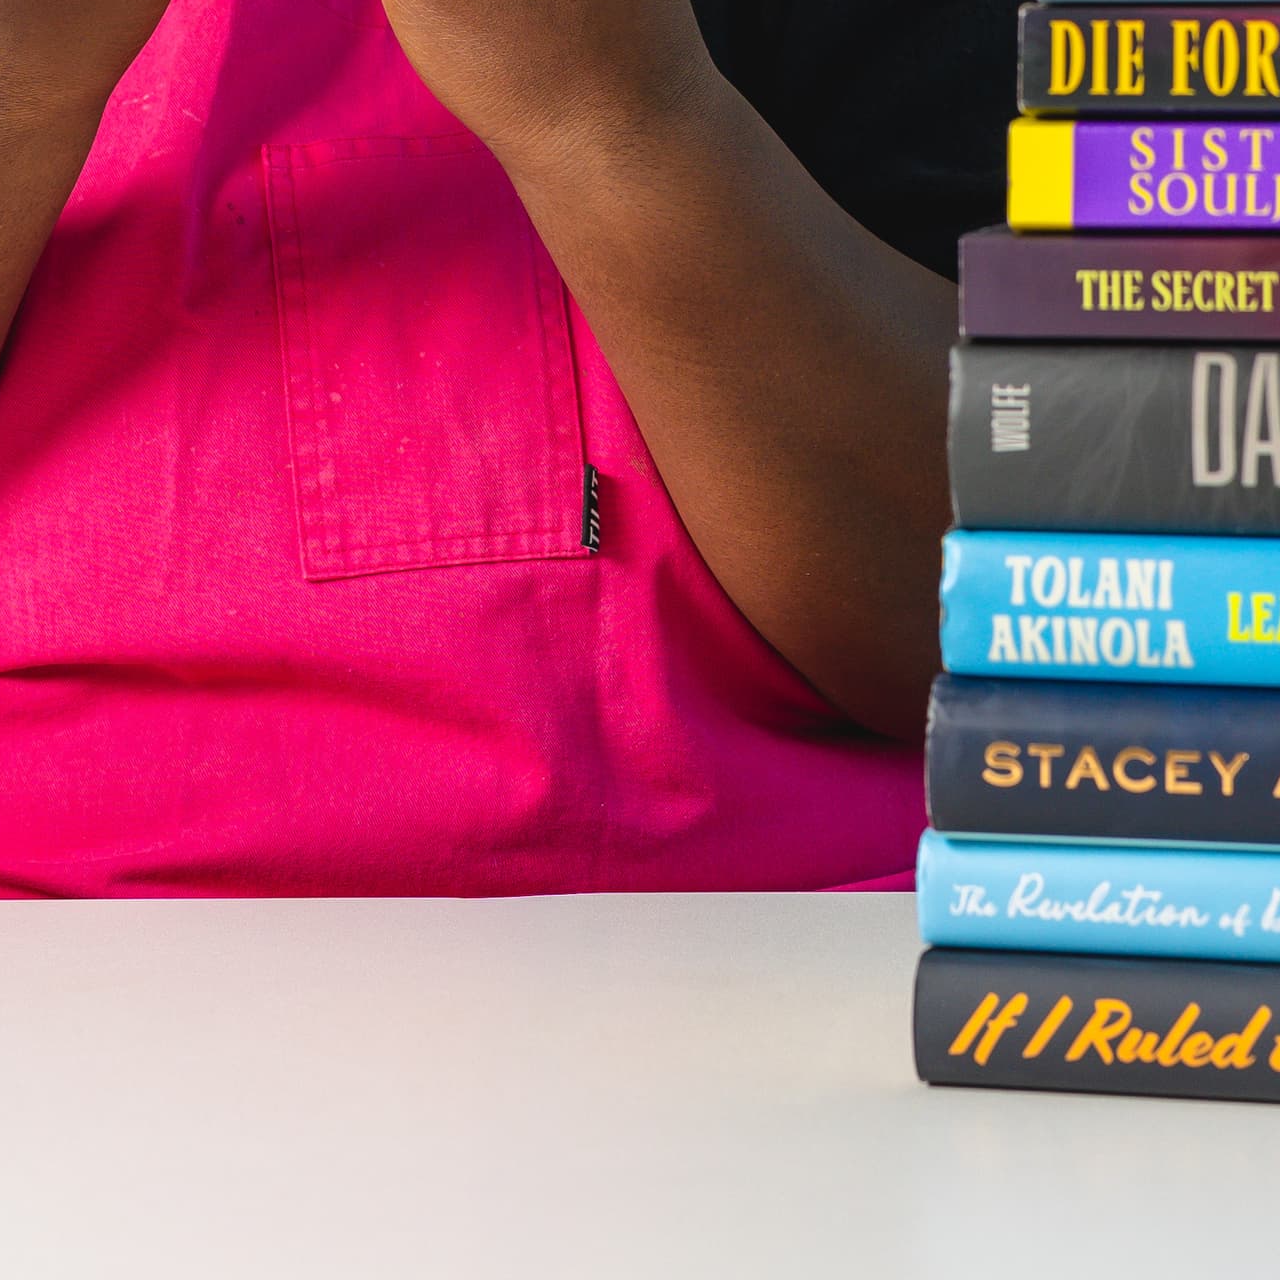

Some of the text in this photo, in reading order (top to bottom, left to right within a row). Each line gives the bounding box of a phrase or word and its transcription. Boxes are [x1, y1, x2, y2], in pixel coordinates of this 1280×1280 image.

[1048, 19, 1145, 96] DIE
[1170, 19, 1280, 97] FOR
[1076, 270, 1143, 311] THE
[1151, 270, 1279, 313] SECRET
[991, 383, 1032, 453] WOLFE
[1005, 556, 1174, 611] TOLANI
[988, 616, 1195, 667] AKINOLA
[982, 741, 1250, 797] STACEY
[949, 882, 996, 917] The
[1007, 872, 1210, 929] Revelation
[1219, 905, 1252, 938] of
[948, 992, 1028, 1066] If
[1023, 995, 1074, 1059] I
[1065, 998, 1272, 1069] Ruled
